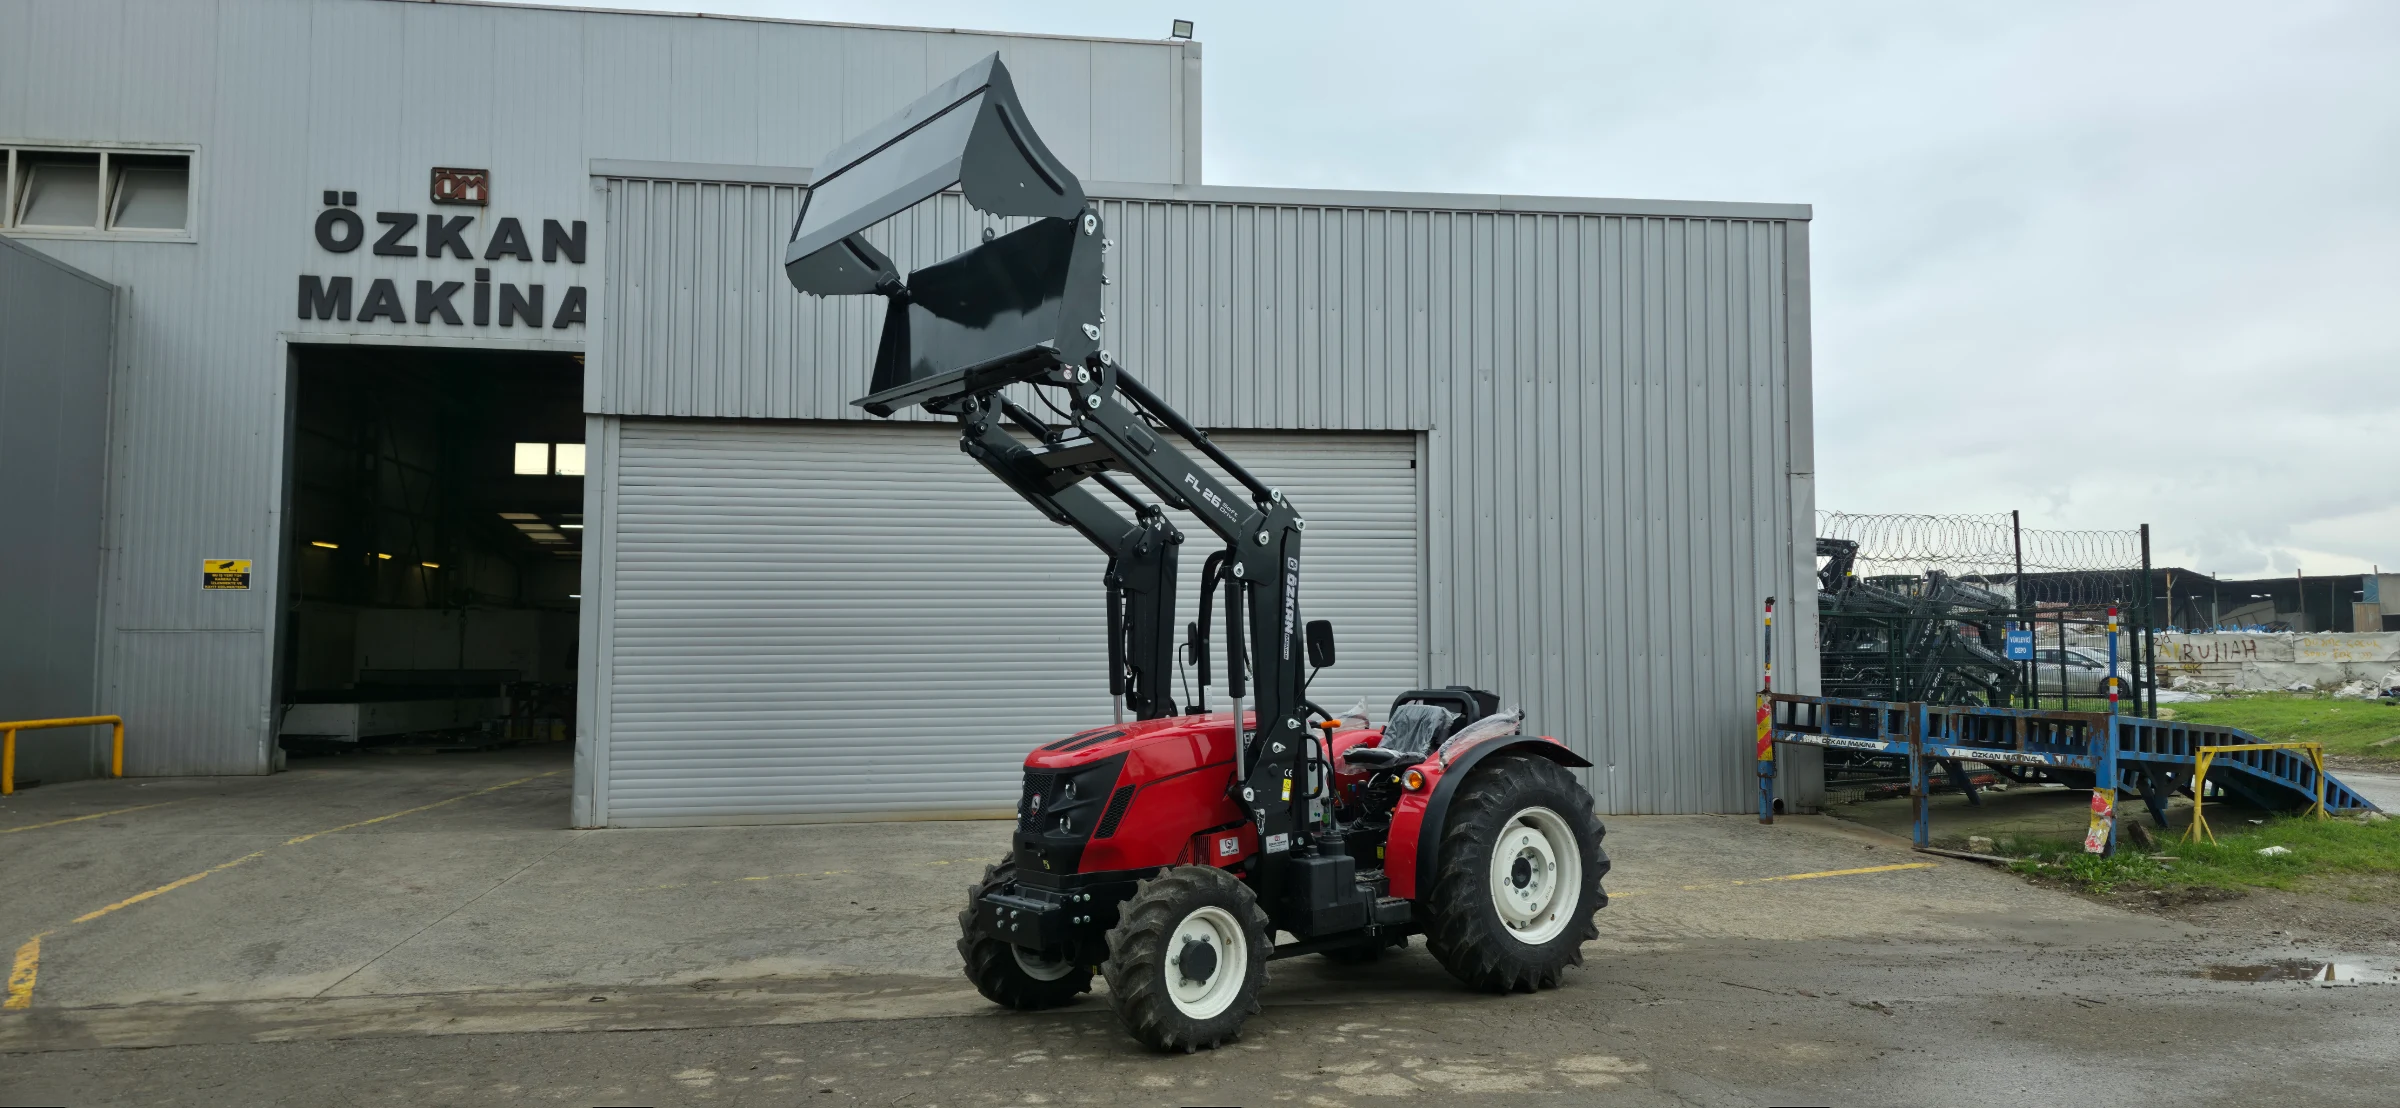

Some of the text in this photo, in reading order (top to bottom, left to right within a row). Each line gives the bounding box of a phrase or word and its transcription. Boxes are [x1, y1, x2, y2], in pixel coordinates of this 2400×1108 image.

[315, 190, 586, 263] ÖZKAN
[298, 268, 586, 328] MAKİNA
[1184, 472, 1222, 508] FL 26
[1222, 502, 1238, 517] Soft
[1219, 507, 1237, 523] Drive
[1285, 573, 1298, 634] ÖZKAN
